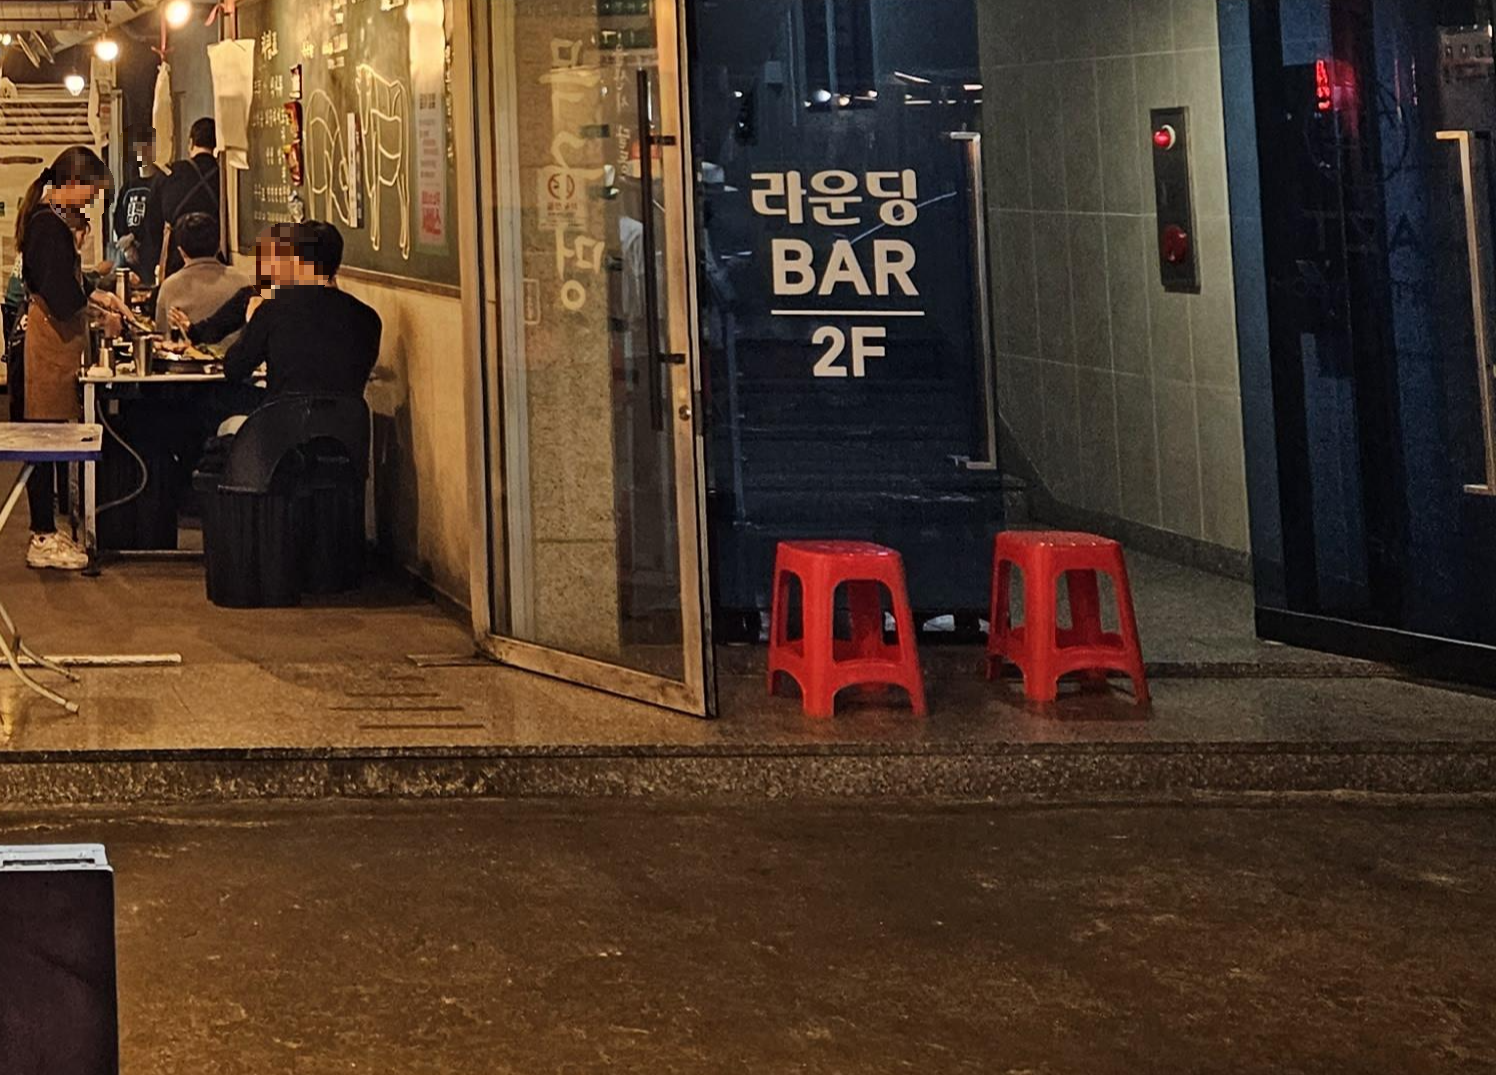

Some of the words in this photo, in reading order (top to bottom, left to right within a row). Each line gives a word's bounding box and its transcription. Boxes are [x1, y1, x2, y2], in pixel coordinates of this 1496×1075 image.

[750, 169, 918, 226] 라운딩
[771, 240, 920, 296] BAR
[811, 325, 886, 377] 2F
